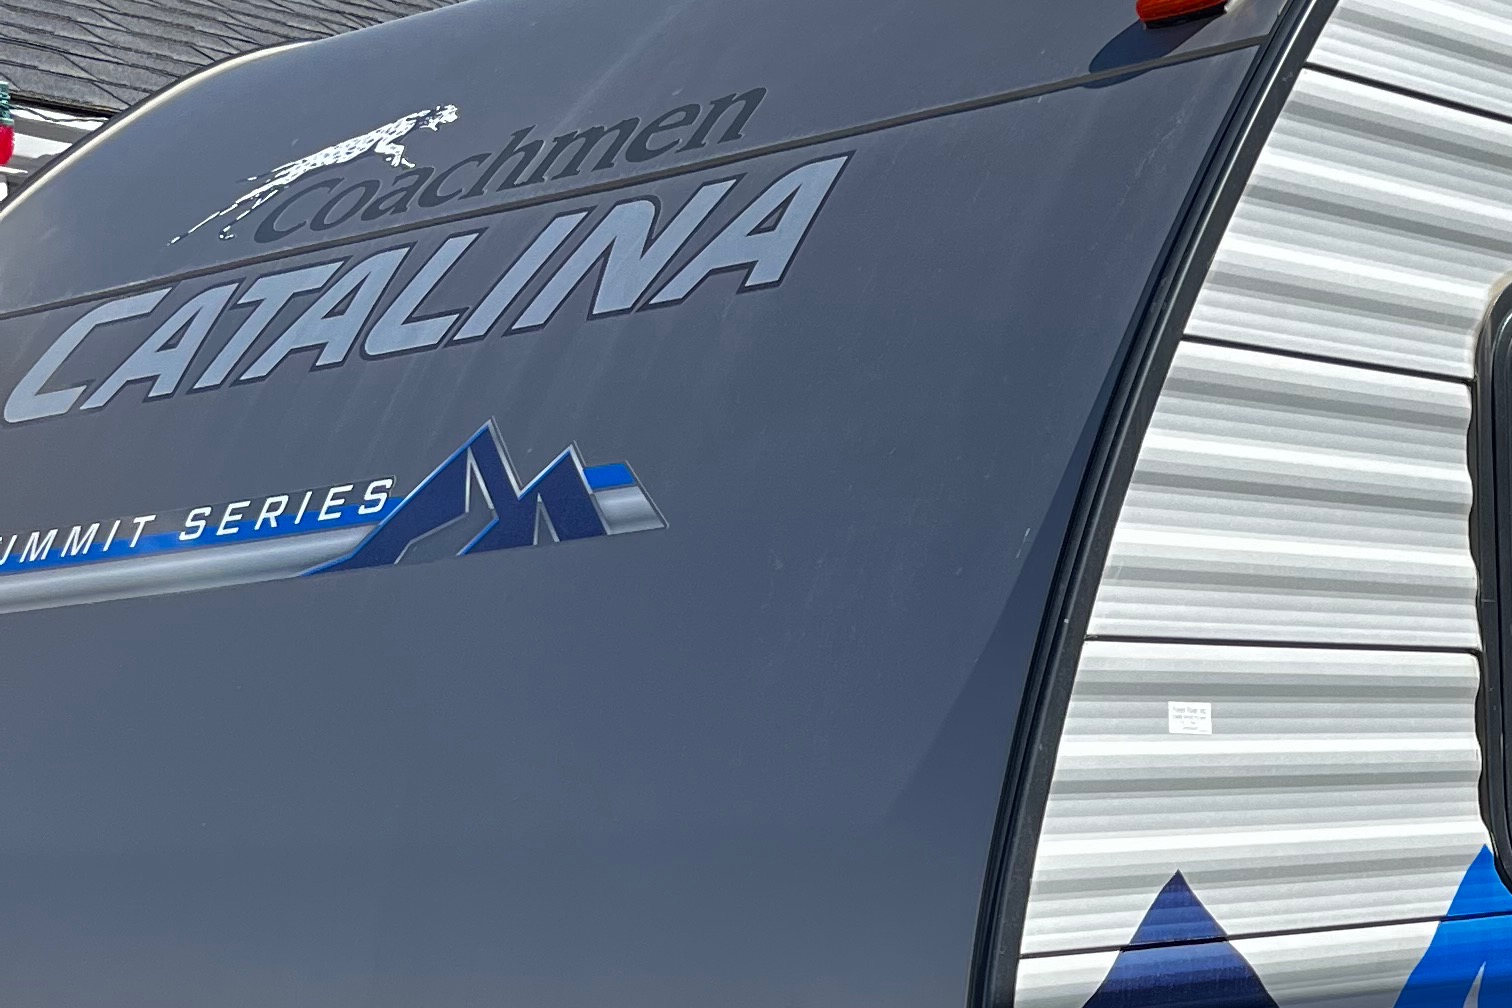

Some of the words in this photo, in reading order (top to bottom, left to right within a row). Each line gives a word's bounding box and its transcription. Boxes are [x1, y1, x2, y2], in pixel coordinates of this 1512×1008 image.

[253, 86, 768, 244] Coachmen
[3, 149, 858, 425] CATALINA
[178, 478, 394, 542] SERIES
